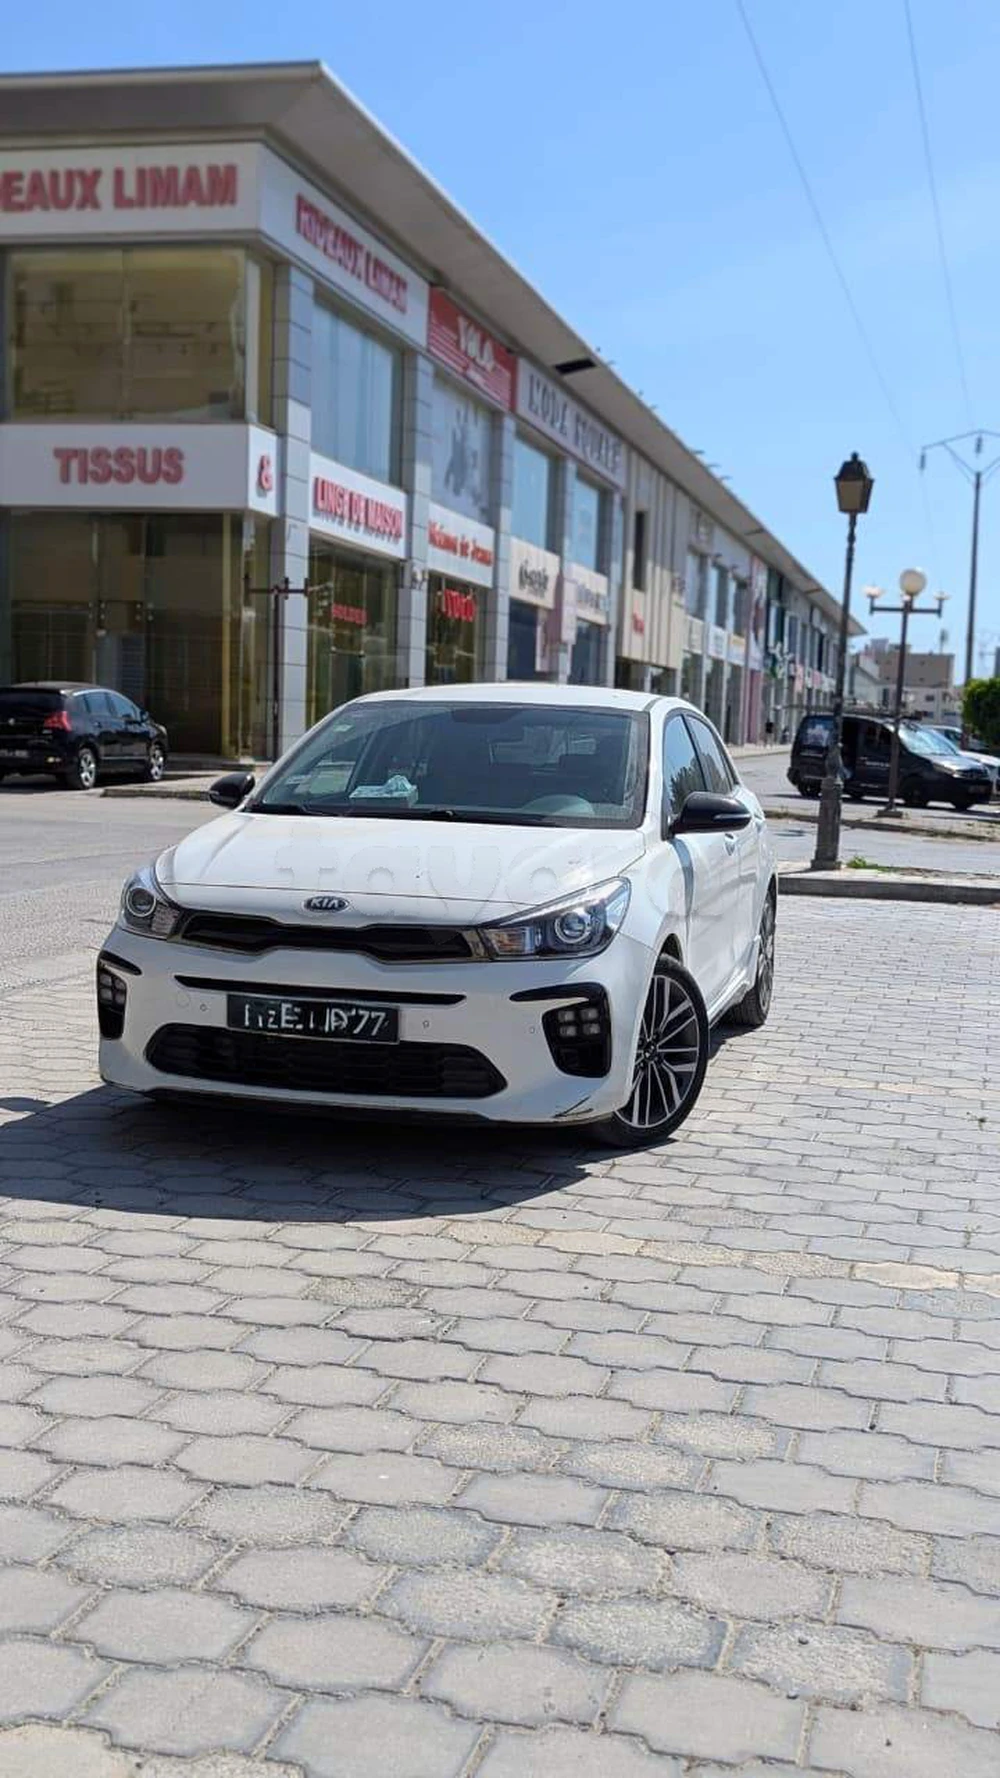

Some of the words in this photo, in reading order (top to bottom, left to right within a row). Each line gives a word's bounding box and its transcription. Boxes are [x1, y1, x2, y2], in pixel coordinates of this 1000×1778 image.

[0, 168, 103, 213] EAUX
[113, 164, 238, 210] LIMAM
[295, 193, 363, 281] RIDEAUX
[54, 447, 184, 485] TISSUS
[258, 454, 274, 492] &
[310, 898, 339, 908] KIA
